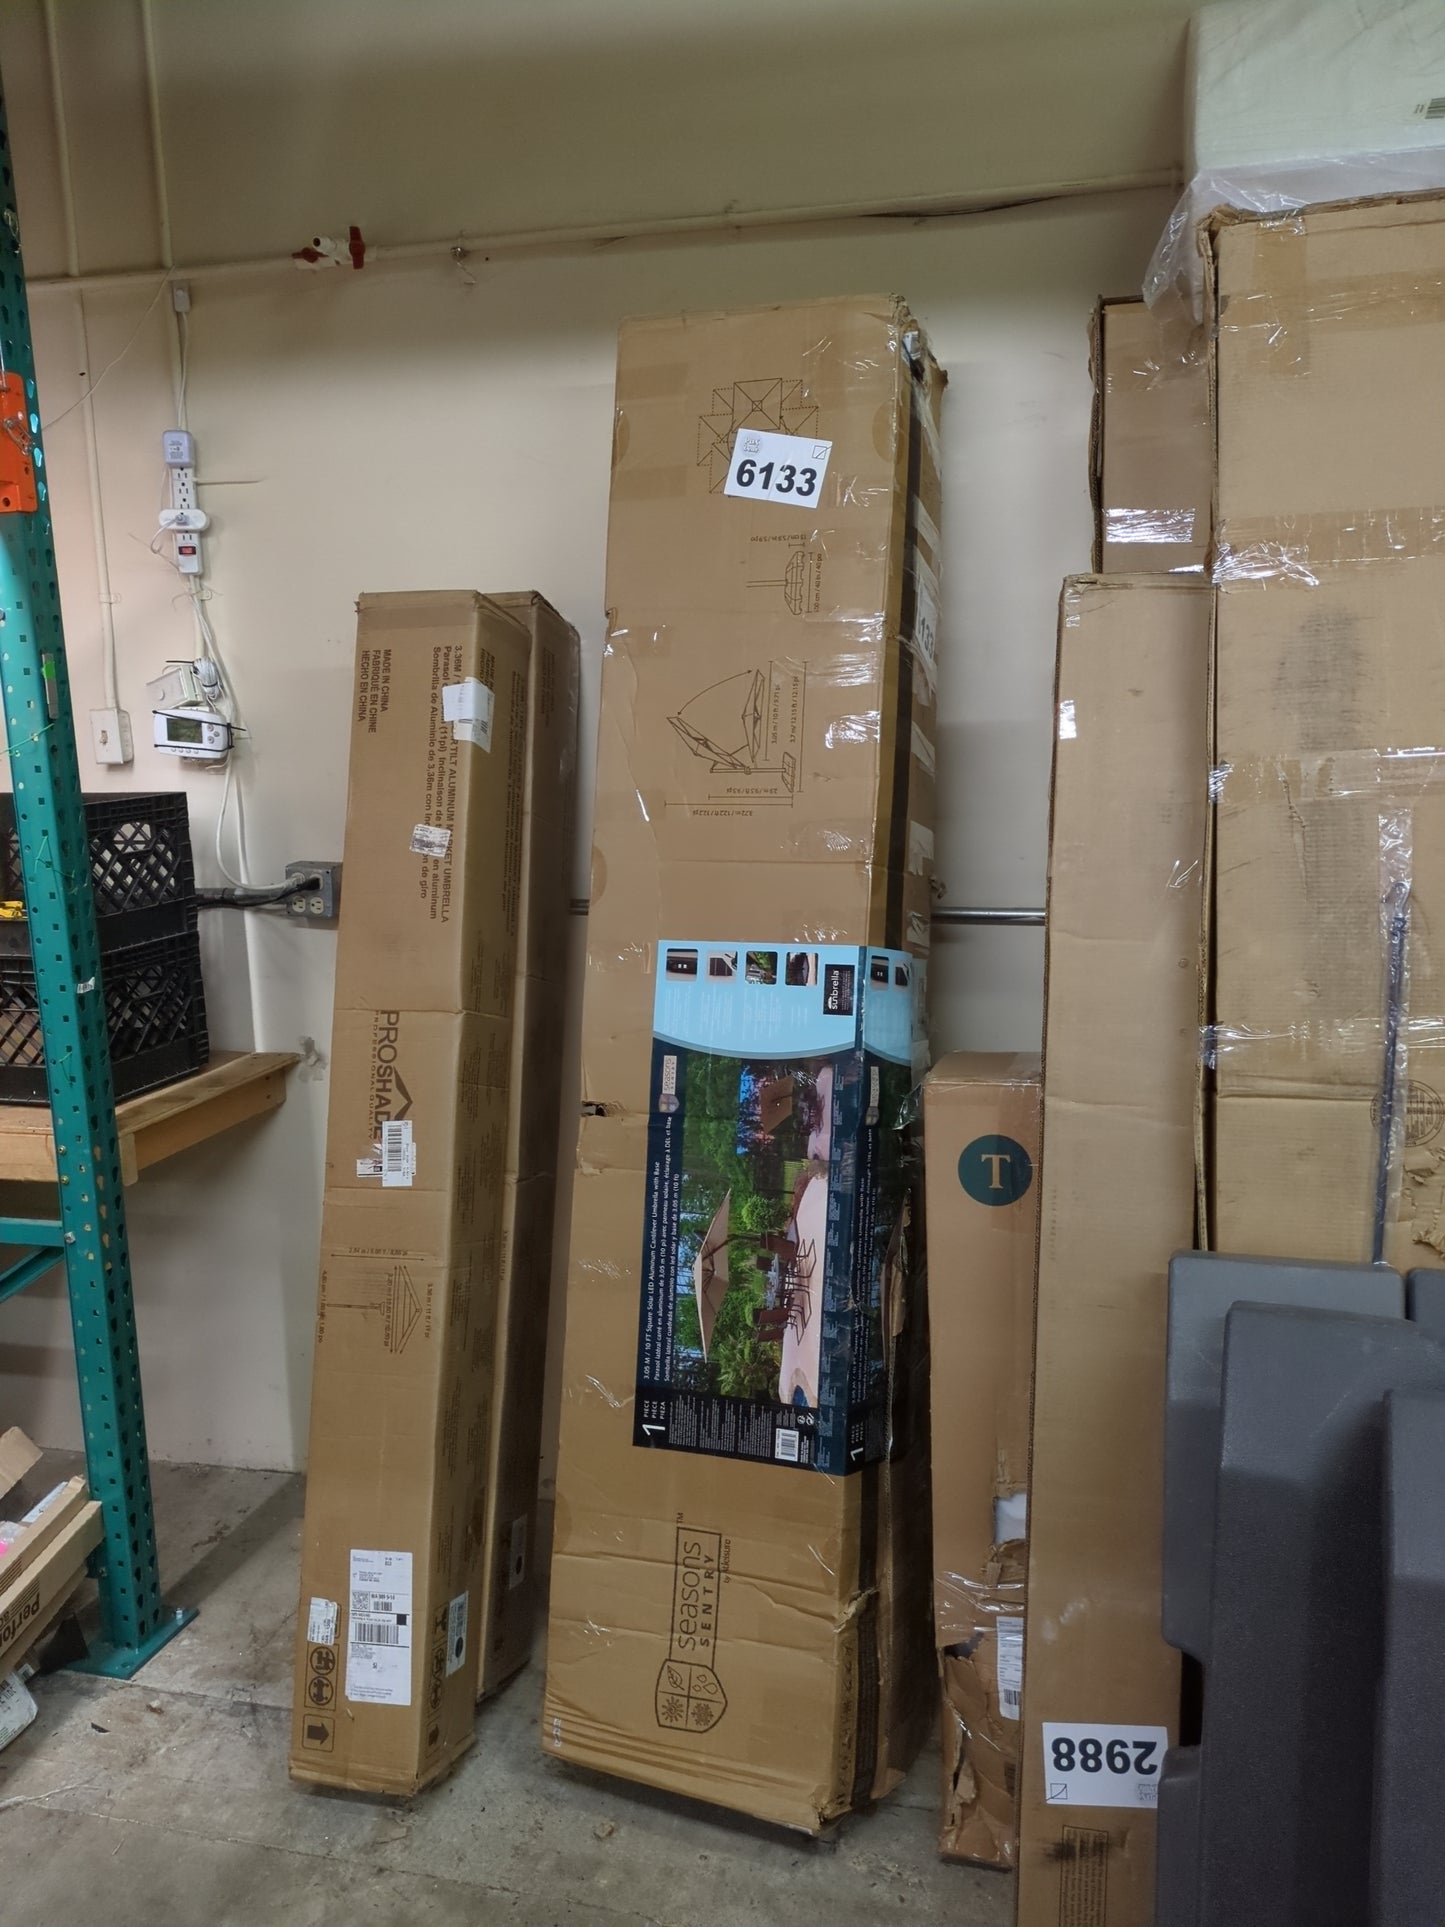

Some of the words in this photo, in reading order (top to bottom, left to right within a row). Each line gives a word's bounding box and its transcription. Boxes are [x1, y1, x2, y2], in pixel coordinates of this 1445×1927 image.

[736, 459, 817, 496] 6133
[360, 650, 370, 680] HECHO
[382, 649, 391, 673] MADE
[432, 647, 441, 690] Sombrilla
[442, 646, 452, 680] Parasol
[453, 645, 462, 672] 3.36M
[359, 682, 368, 693] EN
[382, 676, 390, 684] IN
[358, 695, 368, 722] CHINA
[370, 694, 378, 705] EN
[380, 686, 390, 712] CHINA
[431, 692, 438, 704] de
[368, 707, 377, 733] CHINE
[428, 706, 438, 747] Aluminio
[428, 750, 435, 761] de
[449, 748, 458, 766] TILT
[426, 763, 435, 791] 3,36m
[436, 757, 446, 807] Inclinaison
[447, 769, 457, 822] ALUMINUM
[435, 810, 443, 822] de
[421, 866, 429, 878] de
[432, 859, 439, 870] en
[419, 880, 428, 898] giro
[430, 873, 439, 919] aluminum
[441, 868, 452, 923] UMBRELLA
[830, 970, 839, 1010] sunbrella
[981, 1154, 1011, 1189] T
[651, 1192, 659, 1217] Umbrella
[650, 1220, 658, 1249] Cantilever
[648, 1251, 656, 1280] Aluminum
[645, 1333, 651, 1342] FT
[641, 1424, 666, 1436] 1
[677, 1542, 701, 1651] seasons
[700, 1555, 714, 1647] SENTRY
[1052, 1737, 1158, 1775] 2988
